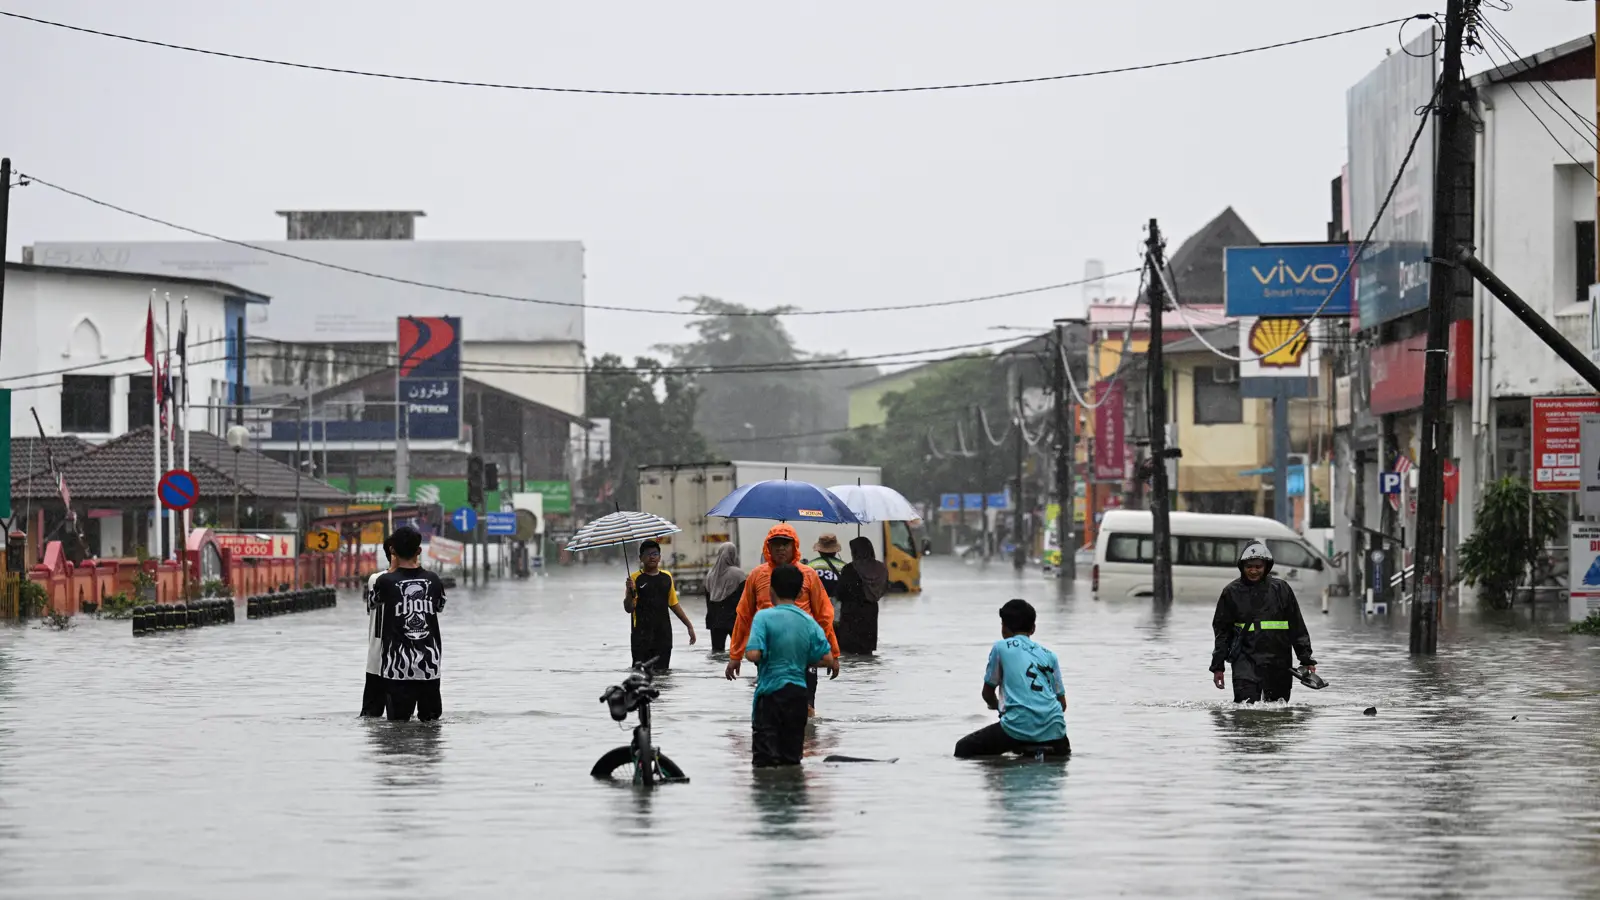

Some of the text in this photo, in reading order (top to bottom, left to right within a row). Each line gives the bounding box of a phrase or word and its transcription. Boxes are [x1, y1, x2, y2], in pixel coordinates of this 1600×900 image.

[1251, 259, 1339, 284] vivo
[1263, 288, 1328, 298] Smart Phone
[409, 403, 449, 413] PETRON
[1385, 474, 1399, 492] P
[318, 532, 329, 550] 3
[245, 545, 268, 554] 000
[1006, 640, 1019, 648] FC
